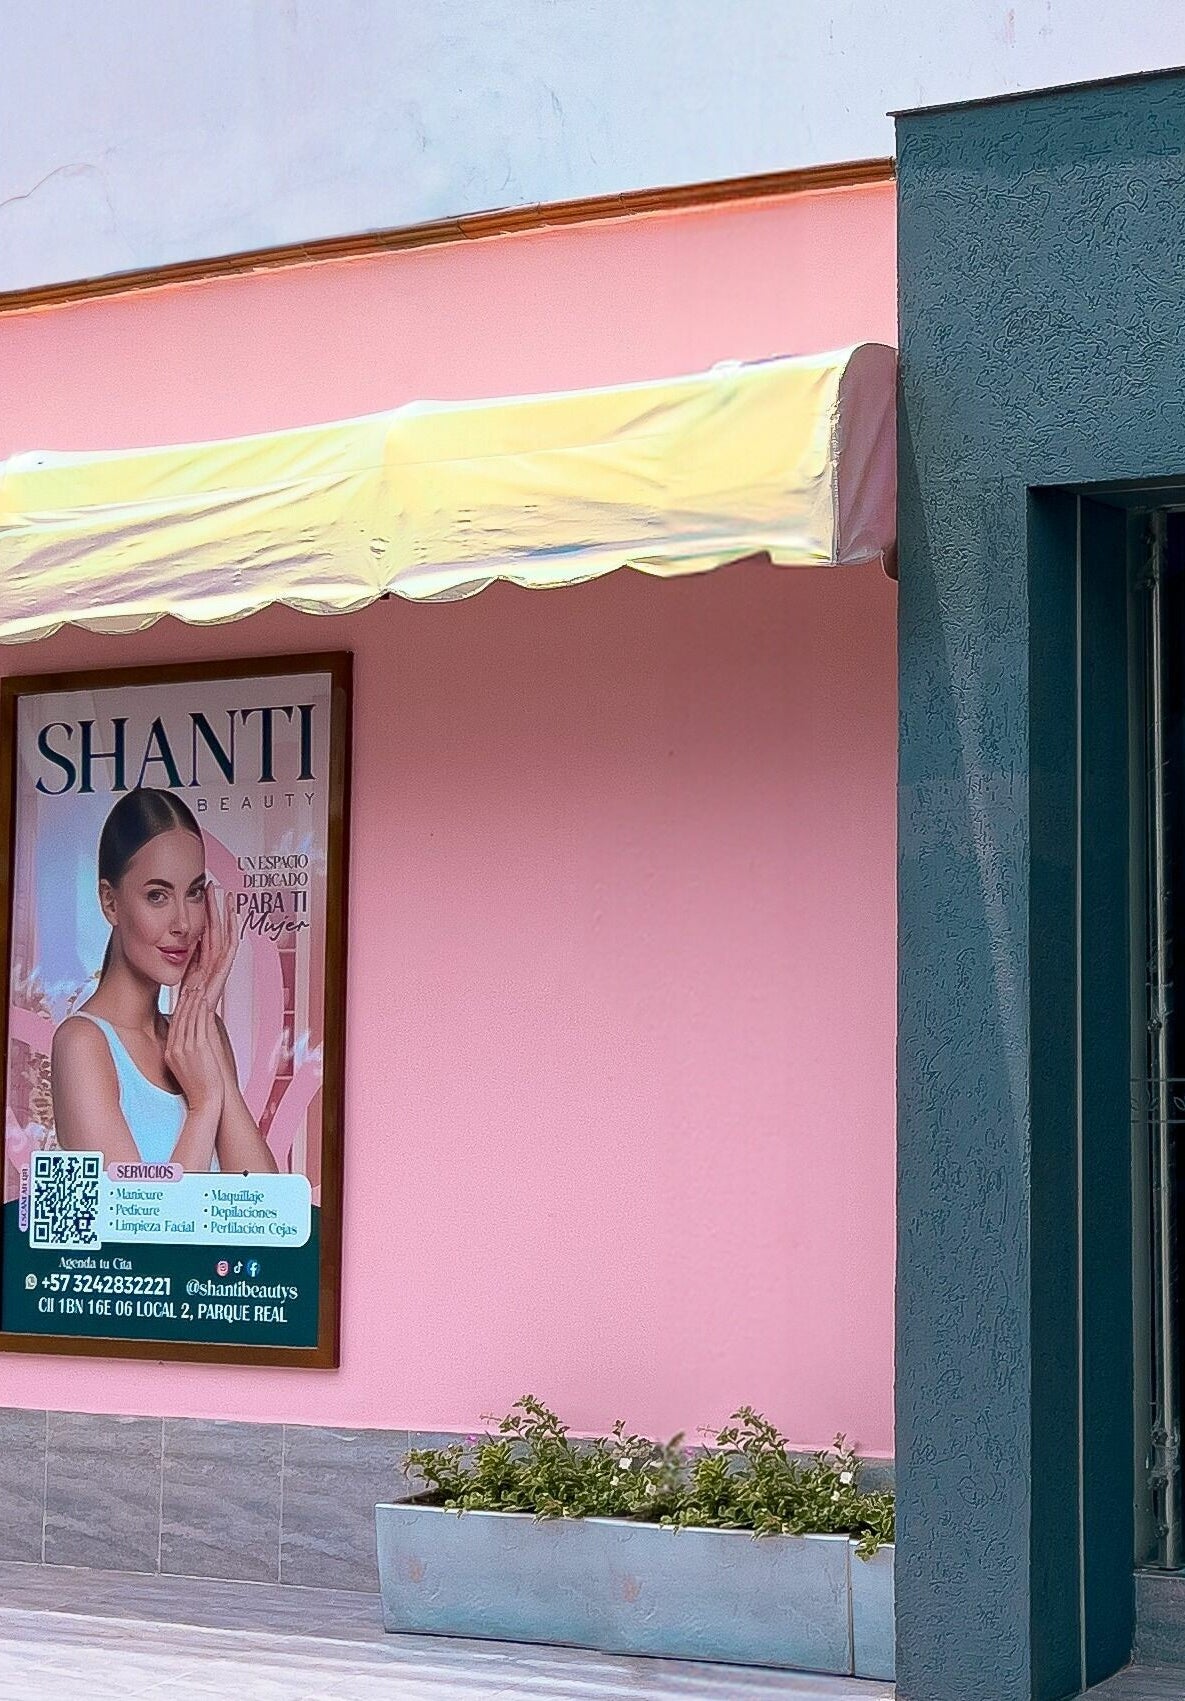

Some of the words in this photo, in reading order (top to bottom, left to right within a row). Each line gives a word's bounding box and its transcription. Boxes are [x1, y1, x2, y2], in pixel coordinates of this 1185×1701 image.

[35, 703, 317, 796] SHANTI
[197, 792, 315, 812] BEAUTY
[237, 856, 256, 871] UN
[258, 853, 309, 870] ESPACIO
[243, 871, 309, 889] DEDICADO
[236, 891, 285, 915] PARA
[290, 890, 307, 913] TI
[240, 909, 310, 941] Mujer
[116, 1164, 174, 1180] SERVICIOS
[115, 1187, 164, 1201] Manicure
[211, 1189, 265, 1206] Maquillaje
[115, 1203, 160, 1216] Pedicure
[210, 1205, 278, 1221] Depilaciones
[115, 1218, 161, 1235] Limpieza
[164, 1220, 195, 1233] Facial
[268, 1222, 298, 1238] Cejas
[58, 1256, 97, 1270] Agenda
[99, 1258, 110, 1270] tu
[112, 1257, 133, 1270] Cita
[72, 1274, 171, 1296] 3242832221
[186, 1278, 299, 1304] @shantibeautys
[58, 1297, 84, 1315] 1BN
[87, 1299, 112, 1316] 16E
[115, 1300, 133, 1317] 06
[136, 1300, 177, 1319] LOCAL
[180, 1302, 193, 1321] 2,
[198, 1303, 251, 1324] PARQUE
[254, 1305, 288, 1323] REAL
